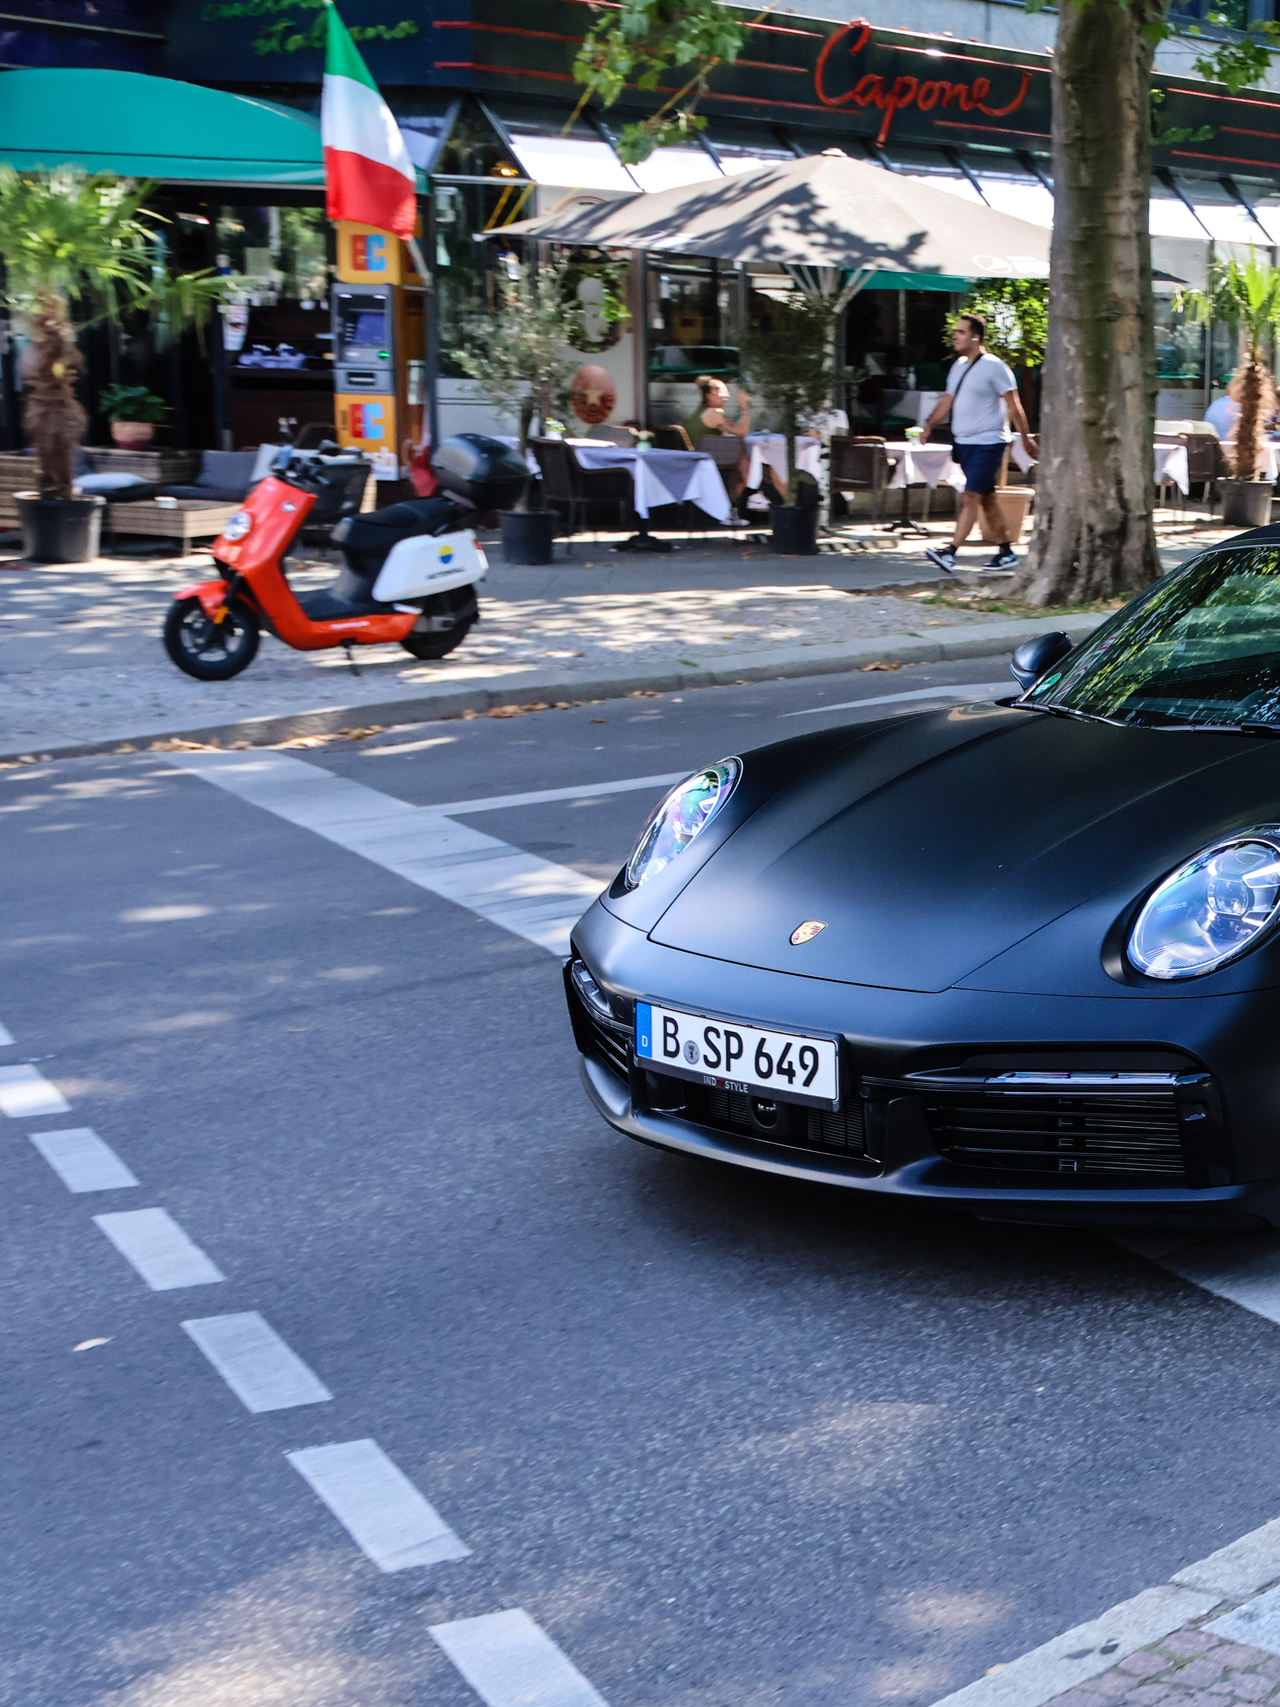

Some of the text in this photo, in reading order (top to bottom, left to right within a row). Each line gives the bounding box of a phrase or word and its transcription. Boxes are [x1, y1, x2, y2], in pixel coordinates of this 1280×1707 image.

[814, 20, 1033, 148] Capone
[641, 1035, 648, 1047] D
[663, 1015, 819, 1088] B SP 649
